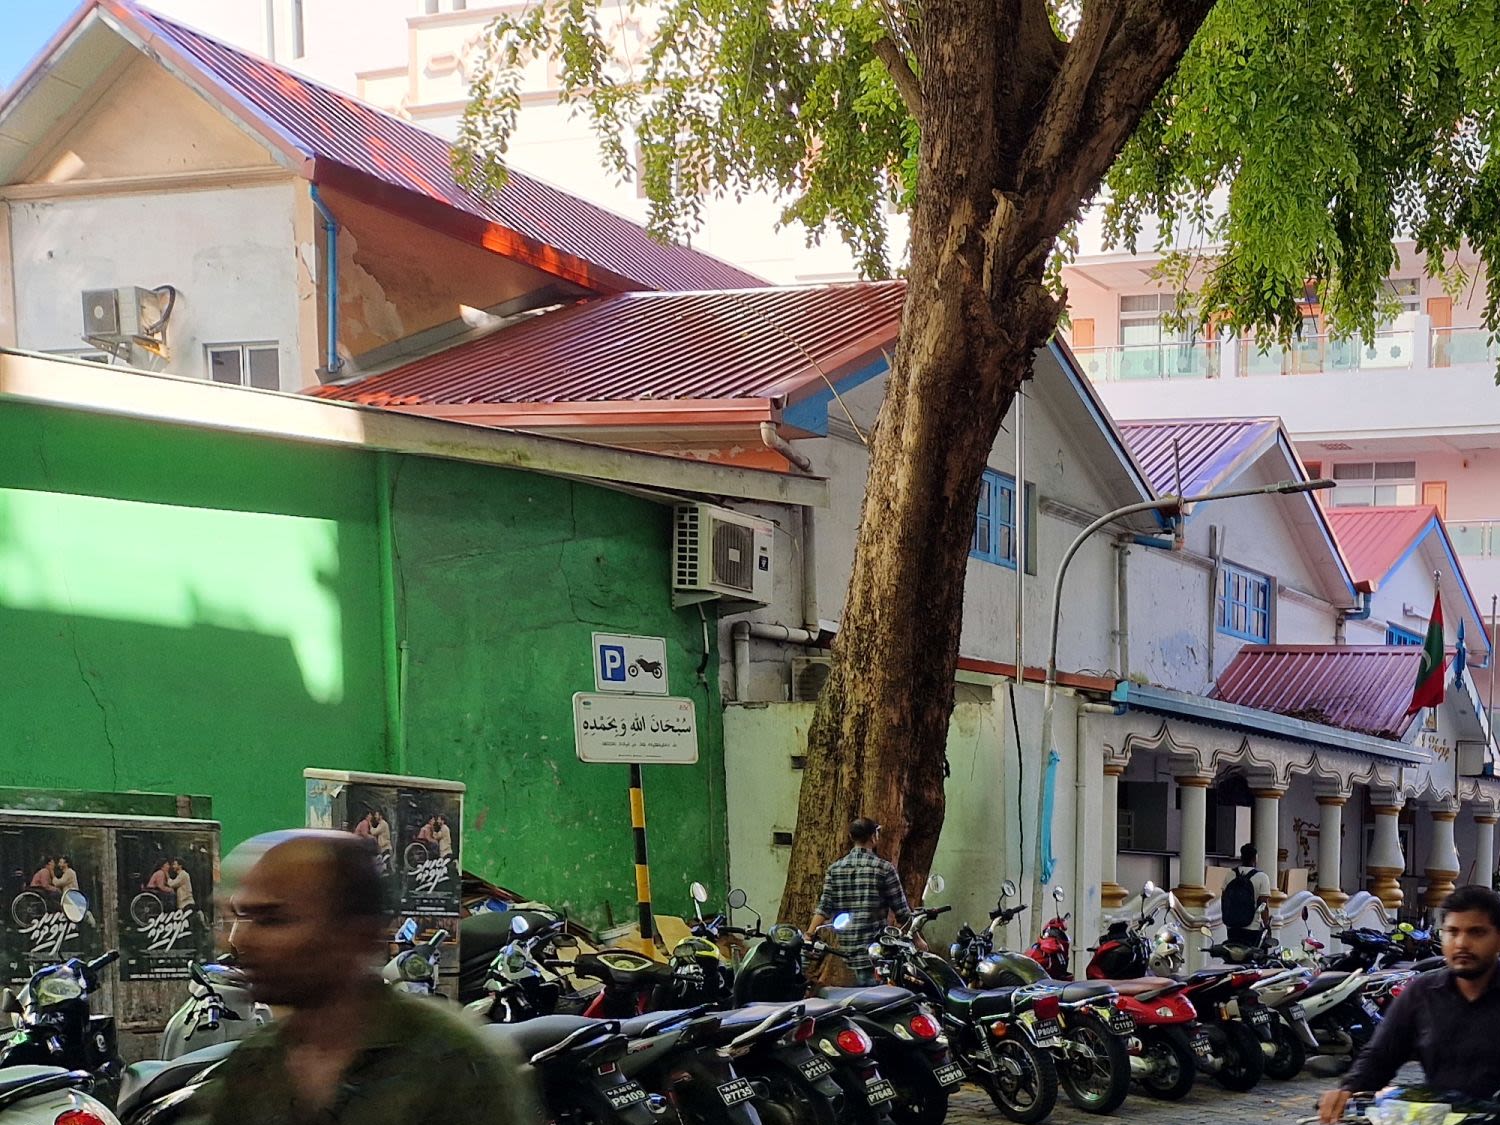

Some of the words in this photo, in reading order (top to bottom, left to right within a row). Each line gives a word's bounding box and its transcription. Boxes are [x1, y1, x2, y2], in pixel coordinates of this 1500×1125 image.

[605, 649, 622, 679] P
[804, 1061, 831, 1079] P2151
[611, 1089, 646, 1107] P8109
[724, 1086, 752, 1102] P7735
